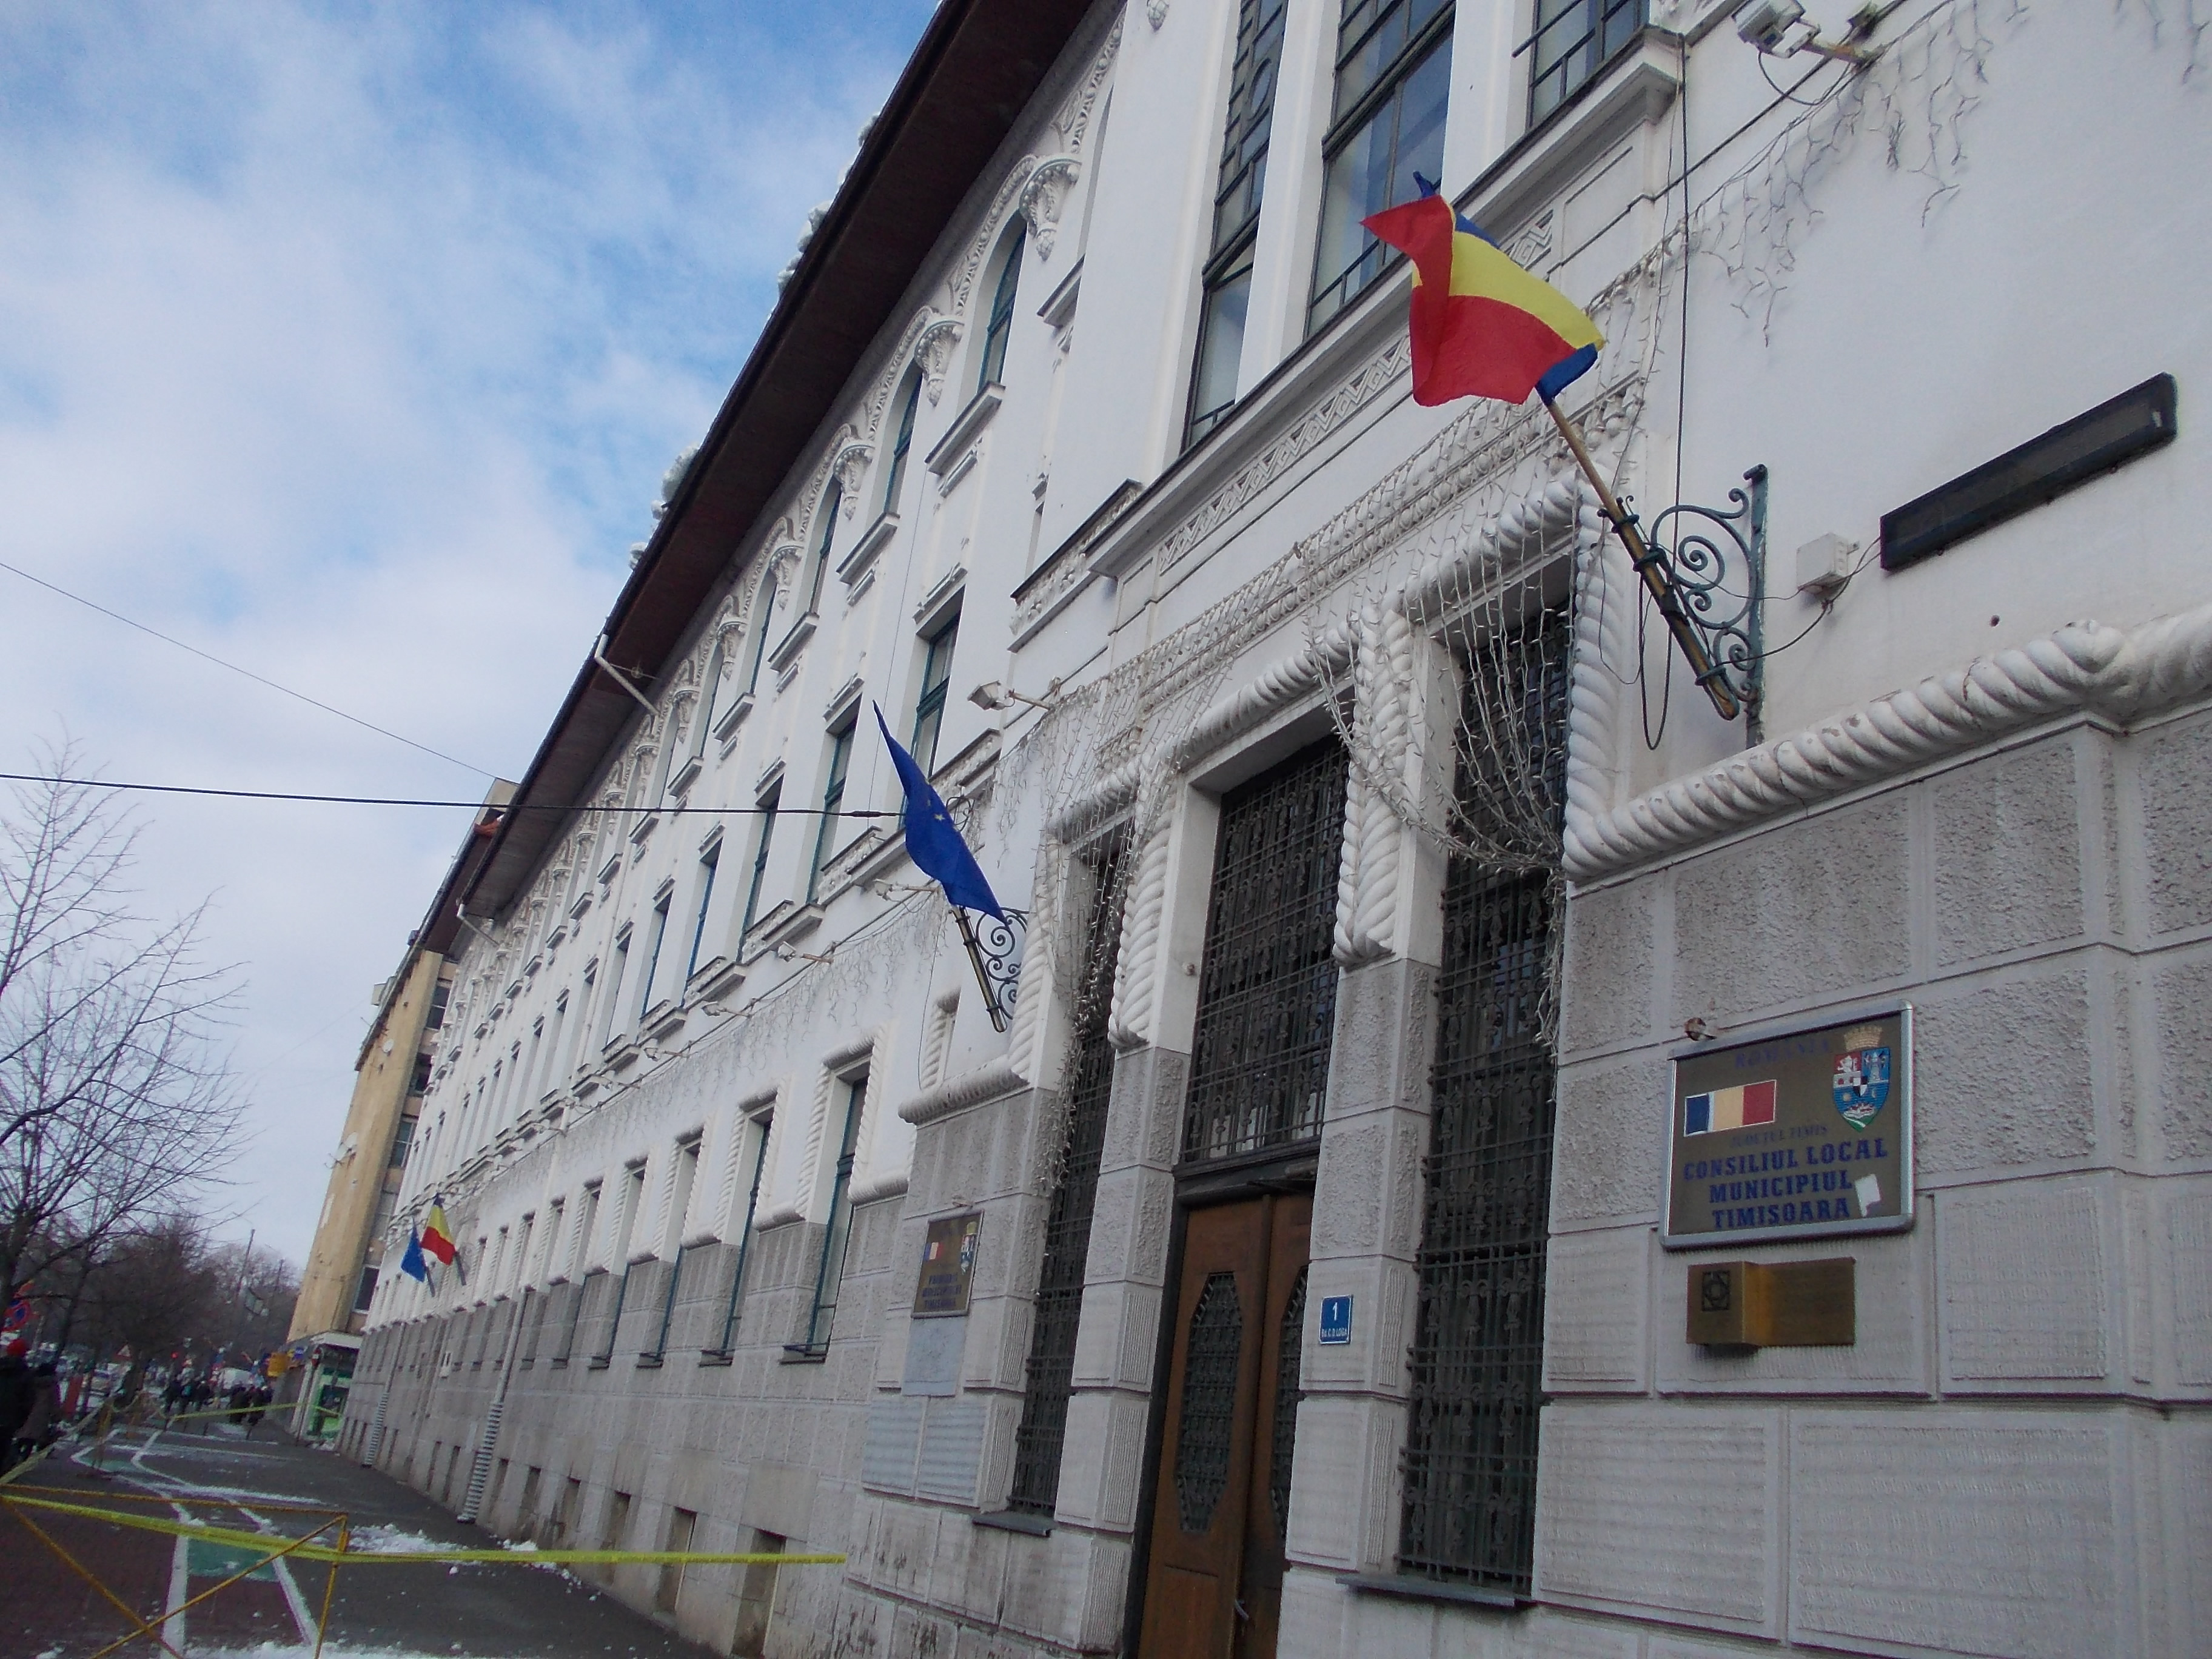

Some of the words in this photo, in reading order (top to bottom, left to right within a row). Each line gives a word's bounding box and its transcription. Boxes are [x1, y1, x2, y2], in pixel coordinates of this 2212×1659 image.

[1683, 1149, 1799, 1181] CONSILIUL
[1806, 1138, 1888, 1165] LOCAL
[1709, 1169, 1852, 1203] MUNICIPIUL
[1712, 1197, 1850, 1228] TIMISOARA
[1332, 1302, 1338, 1321] 1
